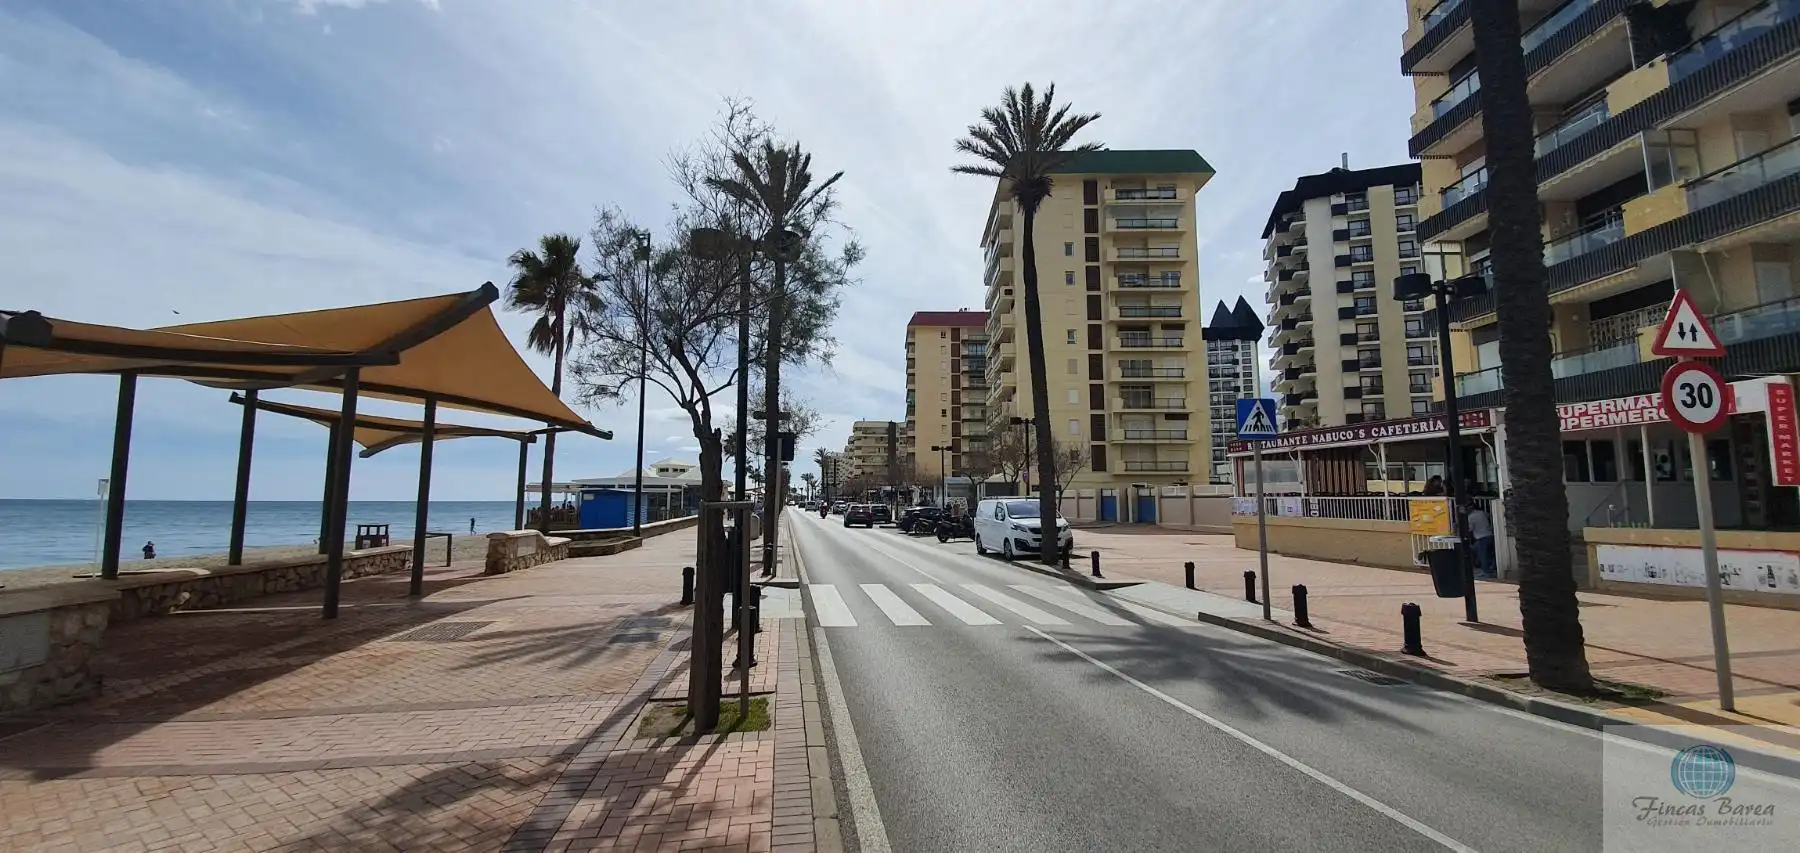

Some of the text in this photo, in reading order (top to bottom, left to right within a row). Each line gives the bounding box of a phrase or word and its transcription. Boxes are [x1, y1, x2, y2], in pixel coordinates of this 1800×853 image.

[1679, 382, 1713, 409] 30
[1247, 435, 1308, 450] RTAURANTE
[1371, 418, 1445, 437] CAFETERÍA
[1776, 389, 1794, 482] SUPERMARKET
